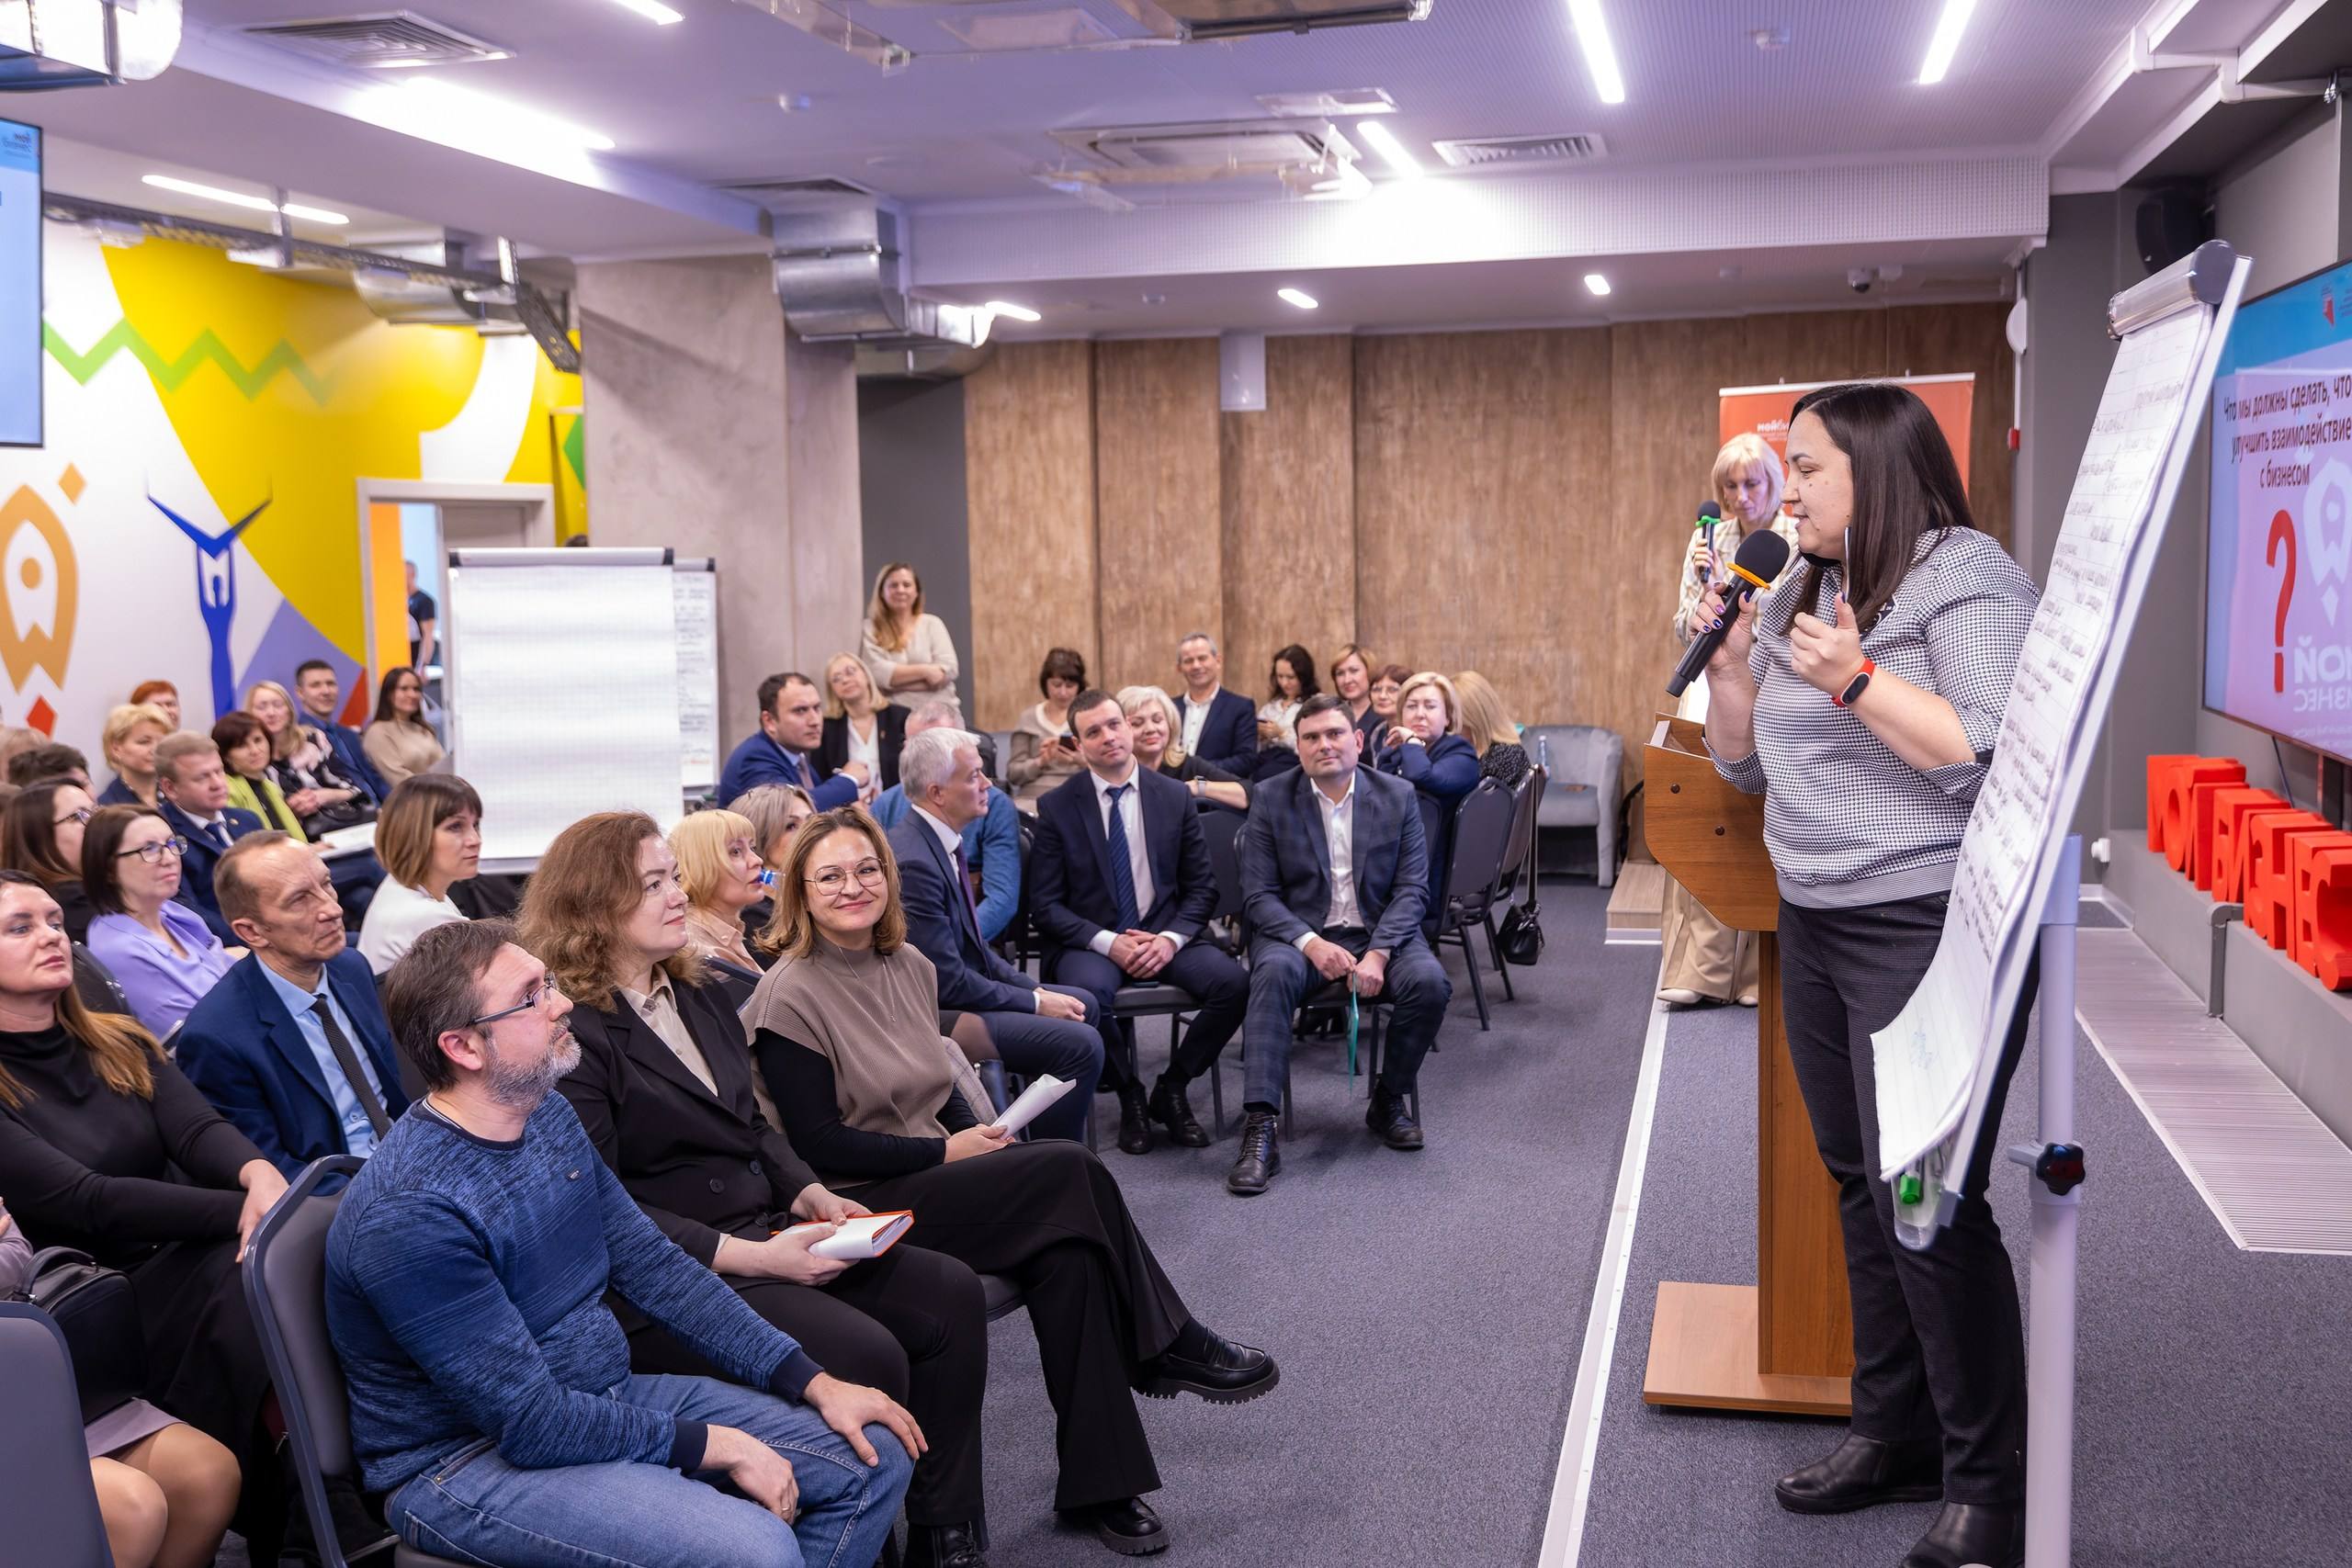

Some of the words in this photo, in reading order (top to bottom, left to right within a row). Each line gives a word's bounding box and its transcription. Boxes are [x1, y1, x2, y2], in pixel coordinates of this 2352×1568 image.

[2224, 397, 2236, 422] Что
[2239, 399, 2250, 420] мы
[2252, 389, 2288, 423] должны
[2290, 381, 2330, 415] сделать,
[2232, 432, 2268, 464] улучшить
[2271, 412, 2352, 453] взаимодействие
[2260, 468, 2265, 489] с
[2267, 458, 2310, 488] бизнесом
